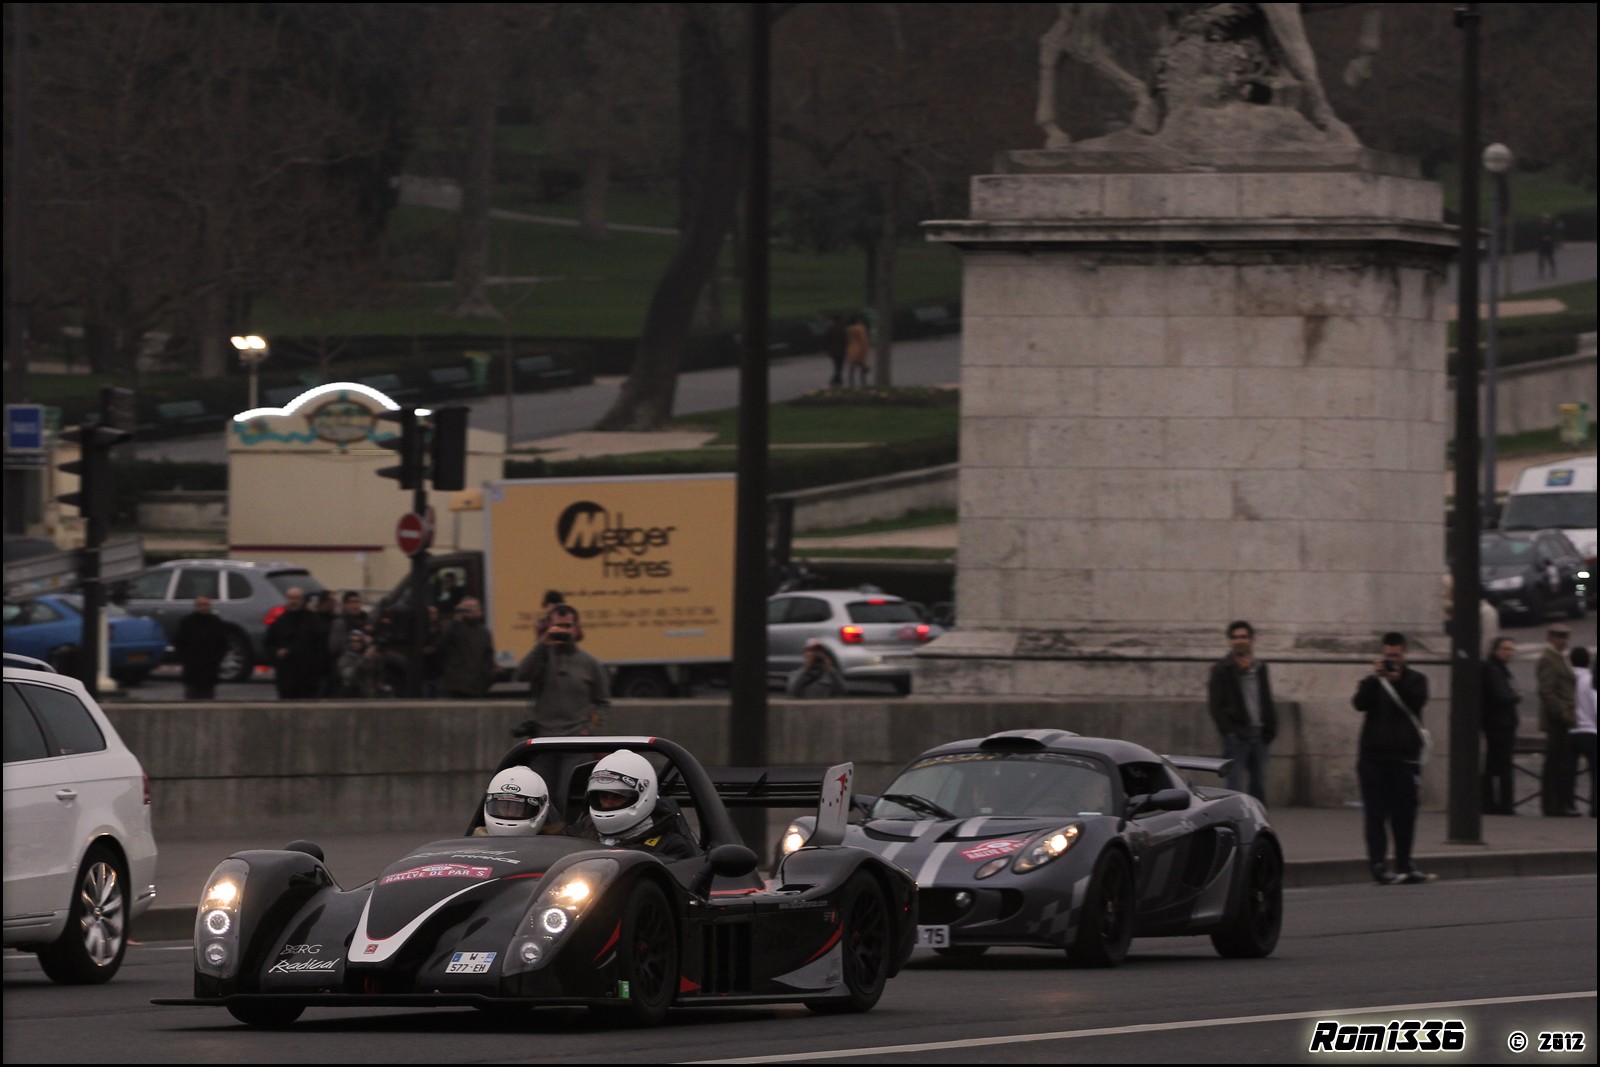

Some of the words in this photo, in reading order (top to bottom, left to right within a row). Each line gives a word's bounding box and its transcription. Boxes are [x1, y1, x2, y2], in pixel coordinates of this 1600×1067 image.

[560, 508, 676, 556] Metzger
[502, 784, 520, 792] Arai
[385, 870, 426, 884] RALLYE
[924, 928, 945, 945] 75
[268, 957, 341, 974] Radical
